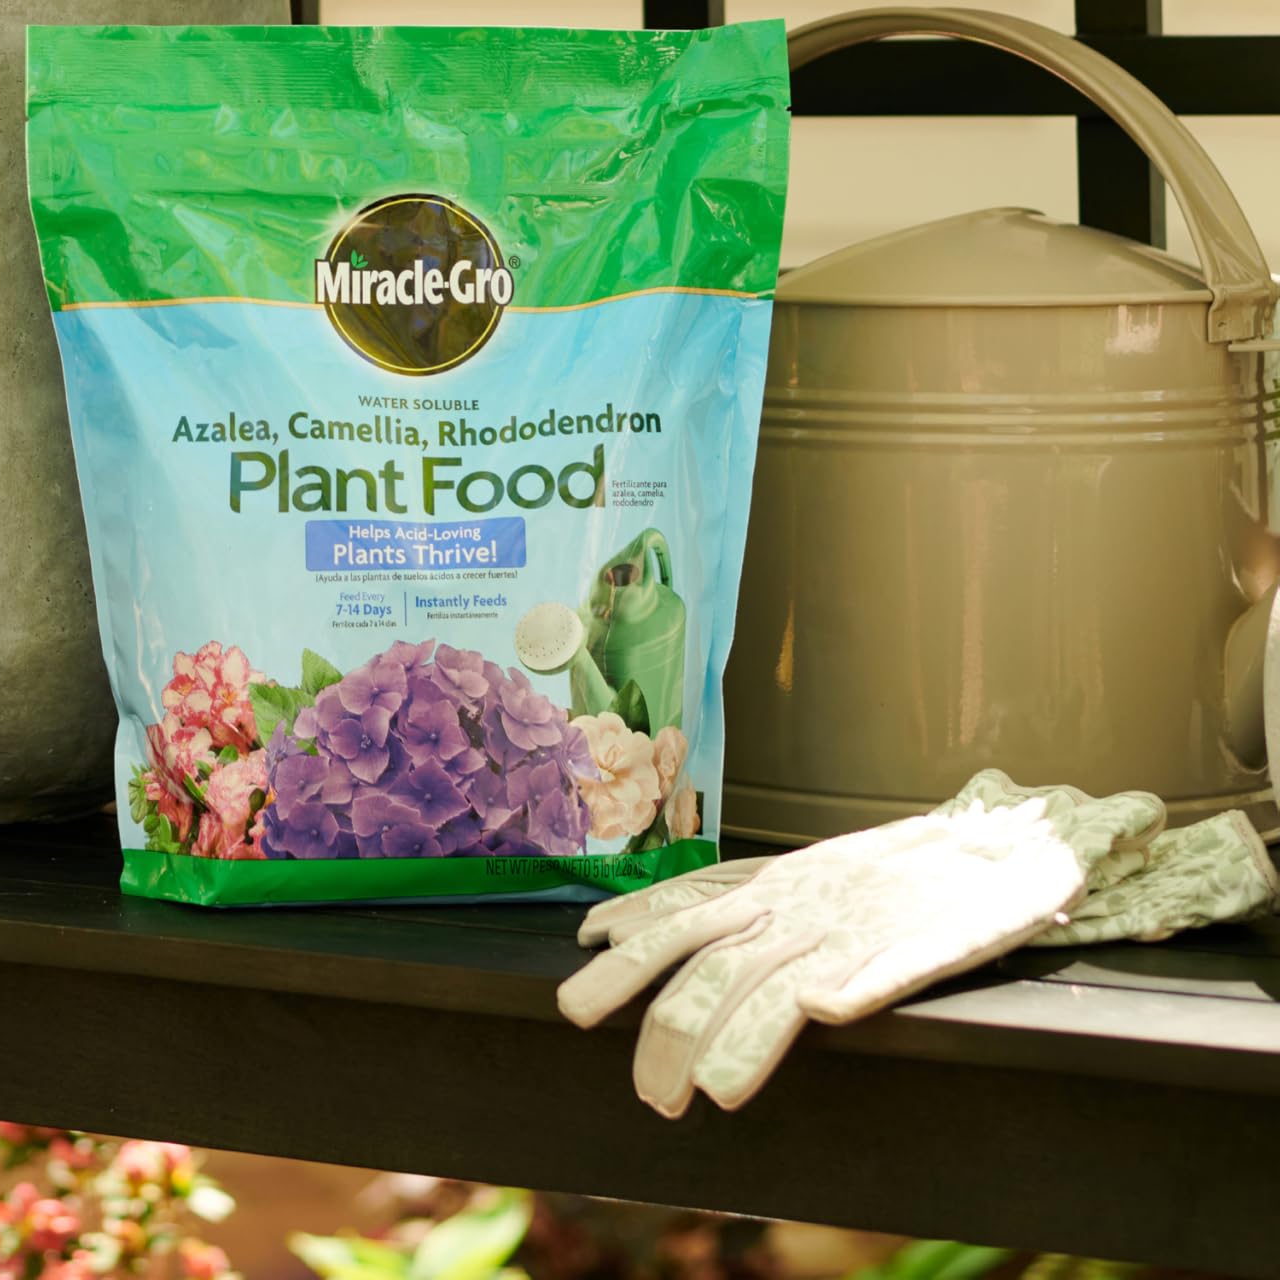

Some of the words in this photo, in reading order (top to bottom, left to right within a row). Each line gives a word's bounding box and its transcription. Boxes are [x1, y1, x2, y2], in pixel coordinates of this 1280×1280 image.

[358, 395, 409, 410] WATER
[413, 398, 480, 411] SOLUBLE
[172, 411, 279, 445] Azalea,
[288, 411, 428, 451] Camellia,
[438, 403, 662, 447] Rhododendron
[229, 449, 408, 514] Plant
[422, 443, 606, 516] Food
[349, 525, 391, 542] Helps
[395, 526, 481, 541] Acid-Loving
[333, 541, 406, 566] Plants
[412, 540, 497, 565] Thrive!
[392, 572, 402, 581] de
[340, 592, 360, 601] Feed
[362, 592, 385, 603] Every
[415, 594, 470, 610] Instantly
[473, 593, 507, 607] Feeds
[336, 604, 360, 615] 7-14
[363, 604, 392, 618] Days
[486, 858, 507, 876] NET
